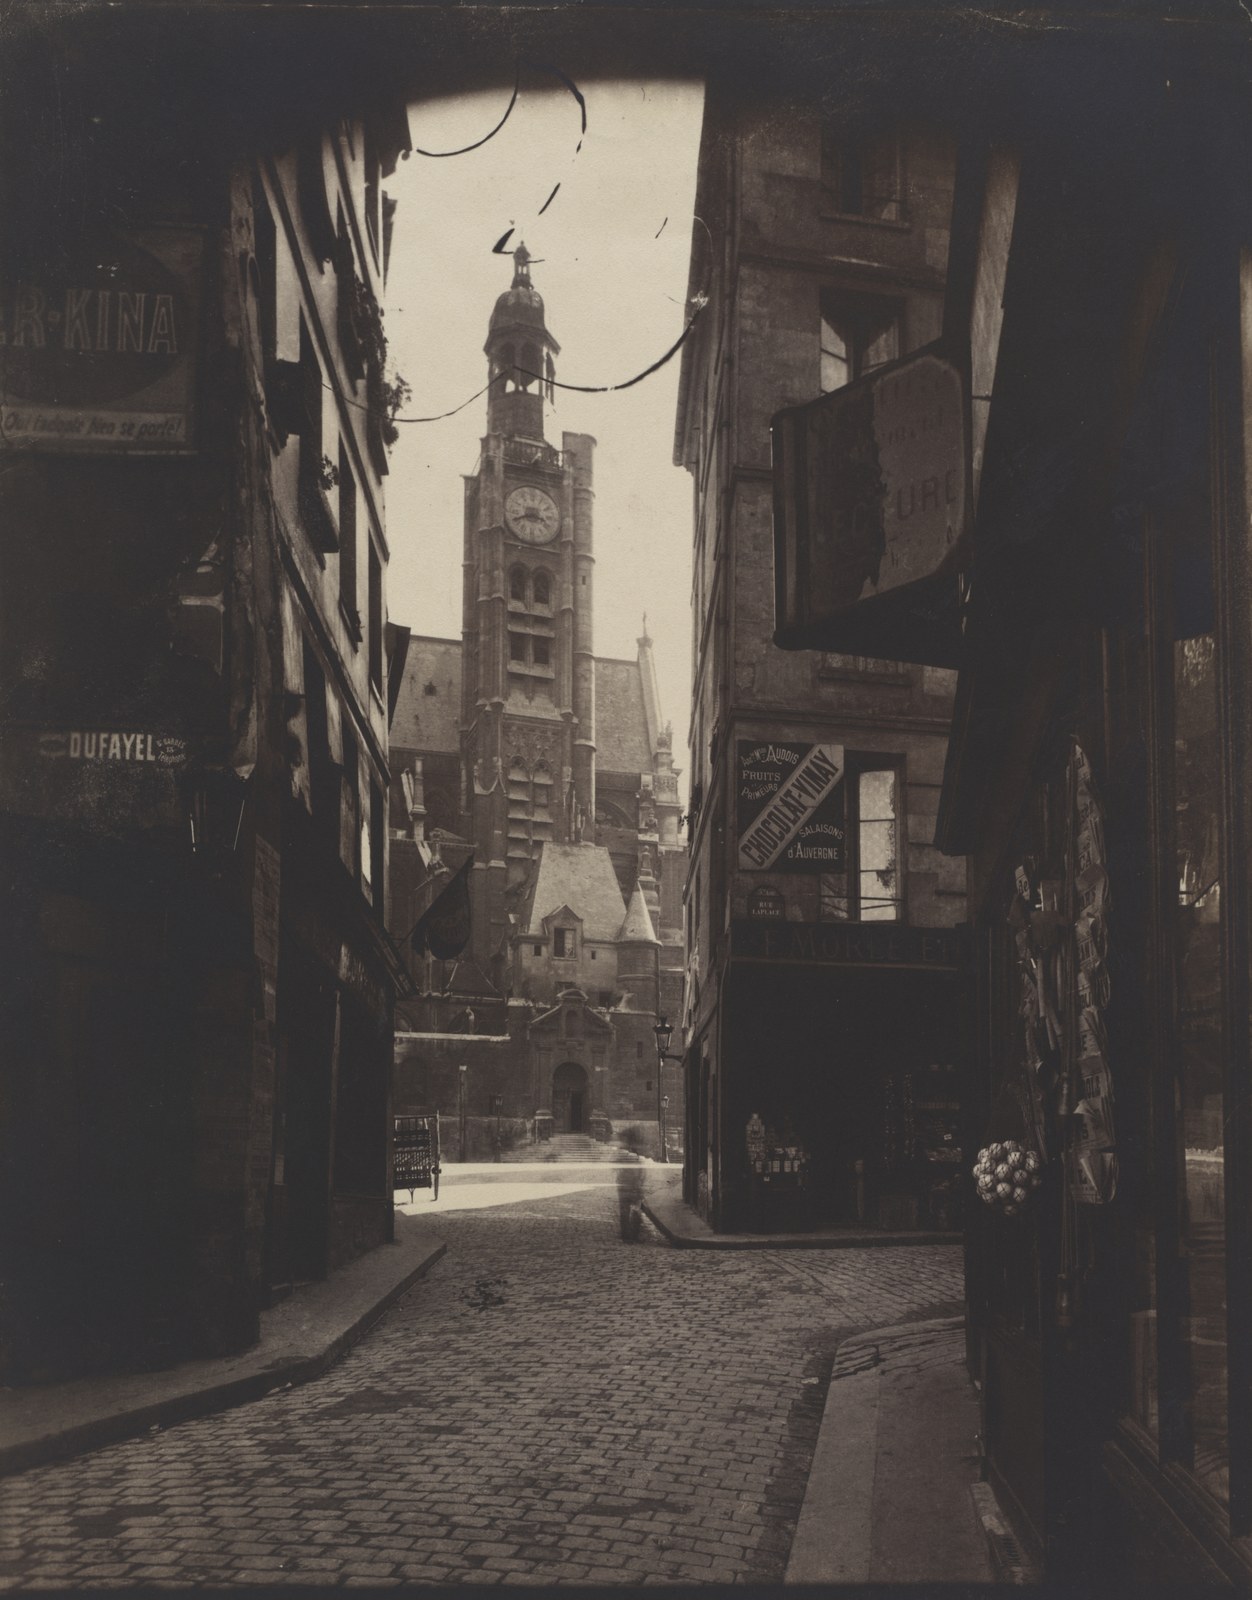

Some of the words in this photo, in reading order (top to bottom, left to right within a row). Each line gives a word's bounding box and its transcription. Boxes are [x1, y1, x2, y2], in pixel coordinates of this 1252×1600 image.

[69, 732, 156, 761] DUFAYEL
[742, 769, 781, 782] FRUITS
[741, 783, 778, 801] PRIMEURS
[799, 824, 844, 840] SALAISONS
[759, 901, 773, 909] RUE
